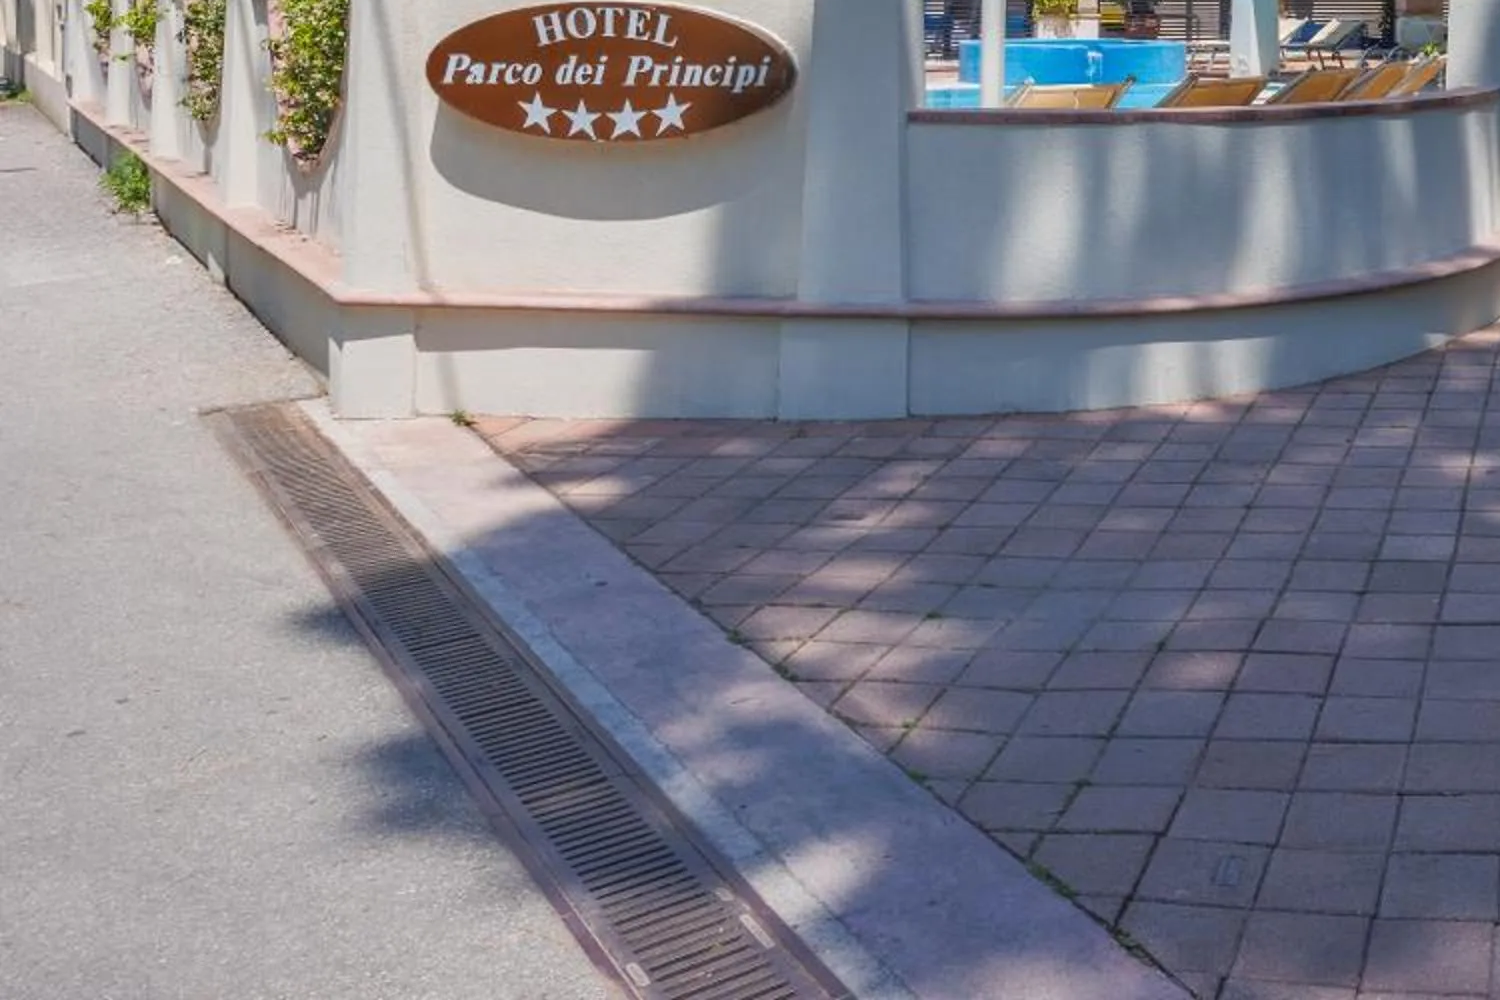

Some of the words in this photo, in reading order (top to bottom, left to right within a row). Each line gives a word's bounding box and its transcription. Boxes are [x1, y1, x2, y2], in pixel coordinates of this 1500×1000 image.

[533, 7, 678, 48] HOTEL
[443, 54, 543, 85] Parco
[555, 55, 608, 86] dei
[622, 55, 772, 93] Principi
